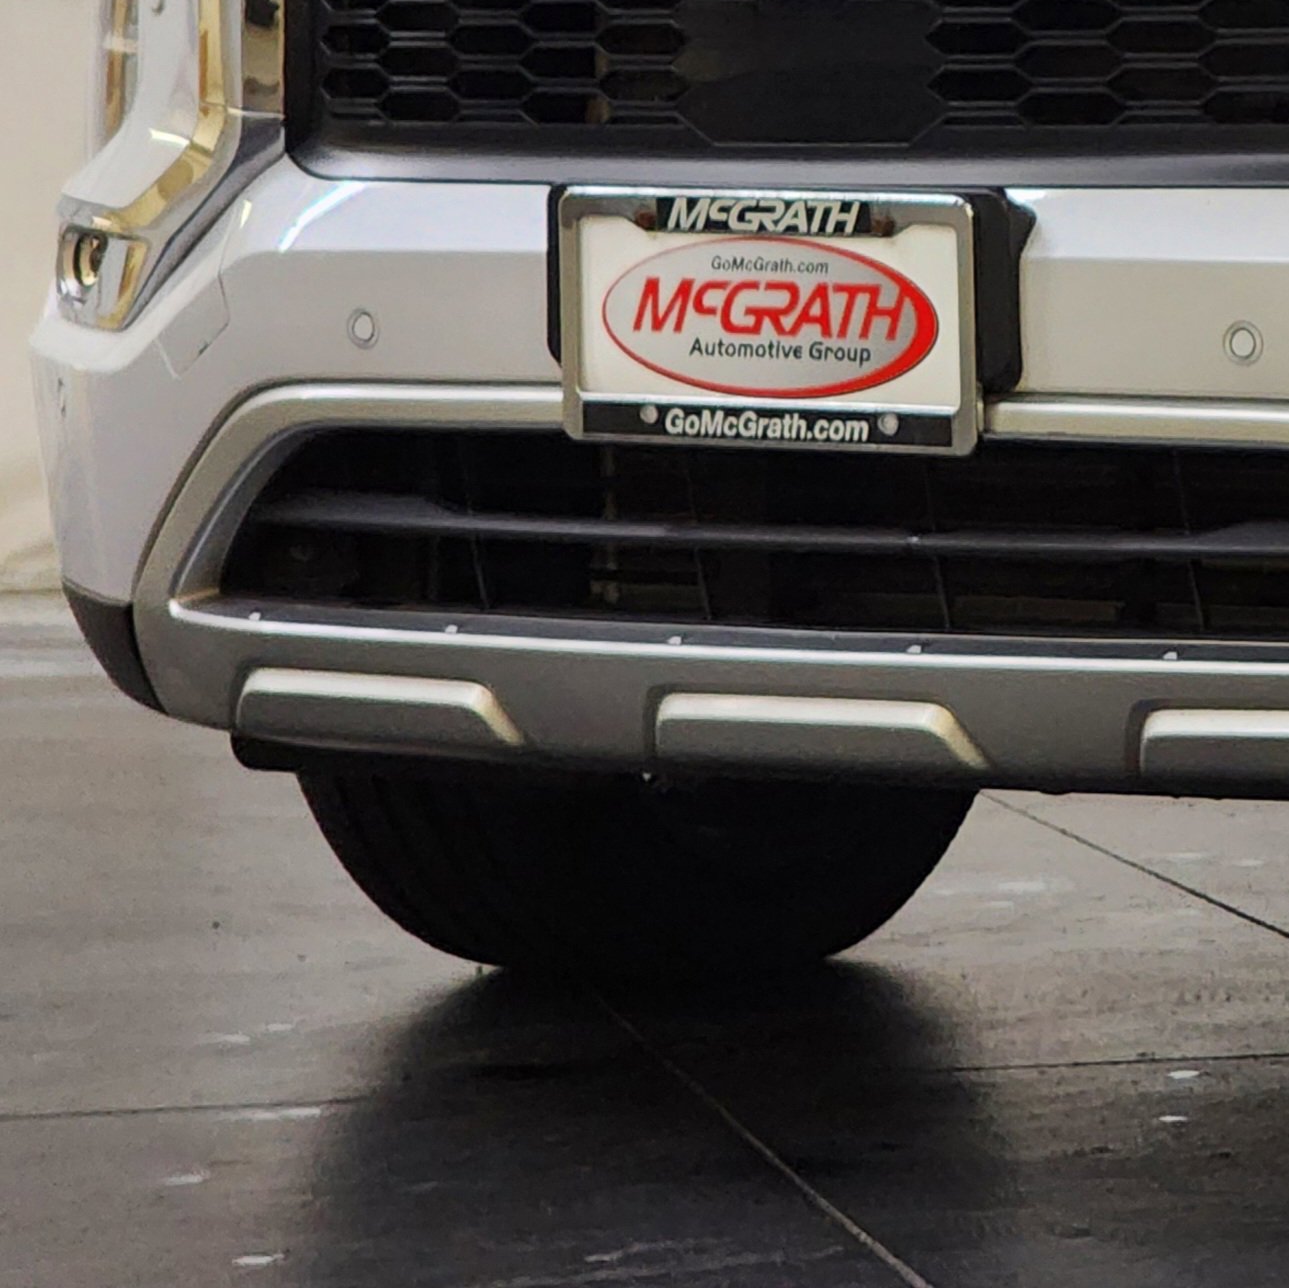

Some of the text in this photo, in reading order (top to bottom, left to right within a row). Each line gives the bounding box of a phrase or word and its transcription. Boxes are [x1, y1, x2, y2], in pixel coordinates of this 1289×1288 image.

[711, 255, 829, 275] GoMcGrath.com
[689, 337, 871, 367] Automotive Group
[665, 407, 869, 441] GoMcGrath.com
